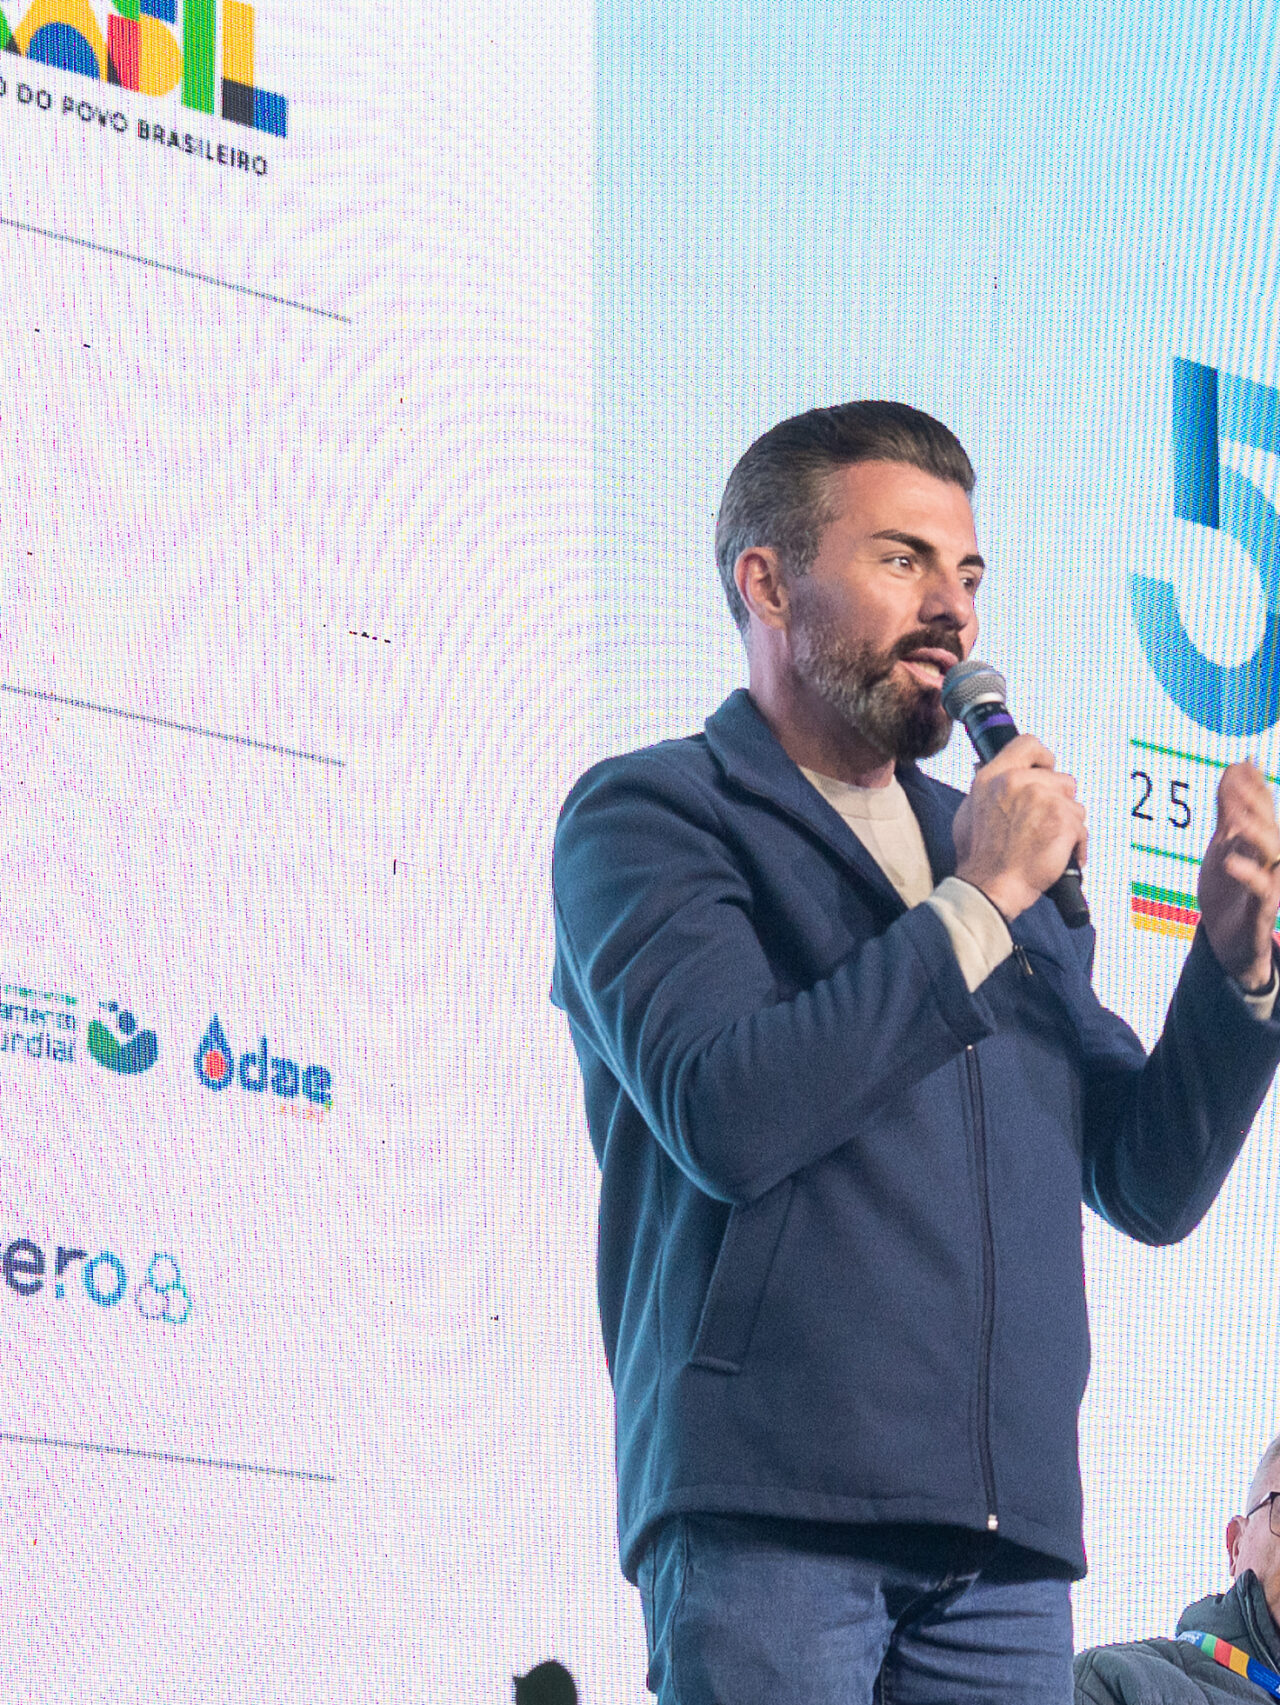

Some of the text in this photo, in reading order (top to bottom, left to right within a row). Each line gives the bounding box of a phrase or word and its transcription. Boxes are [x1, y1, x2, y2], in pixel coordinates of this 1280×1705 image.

[17, 82, 51, 110] DO
[61, 95, 129, 133] POVO
[137, 118, 269, 176] BRASILEIRO
[1130, 770, 1192, 829] 25
[239, 1035, 332, 1104] dae
